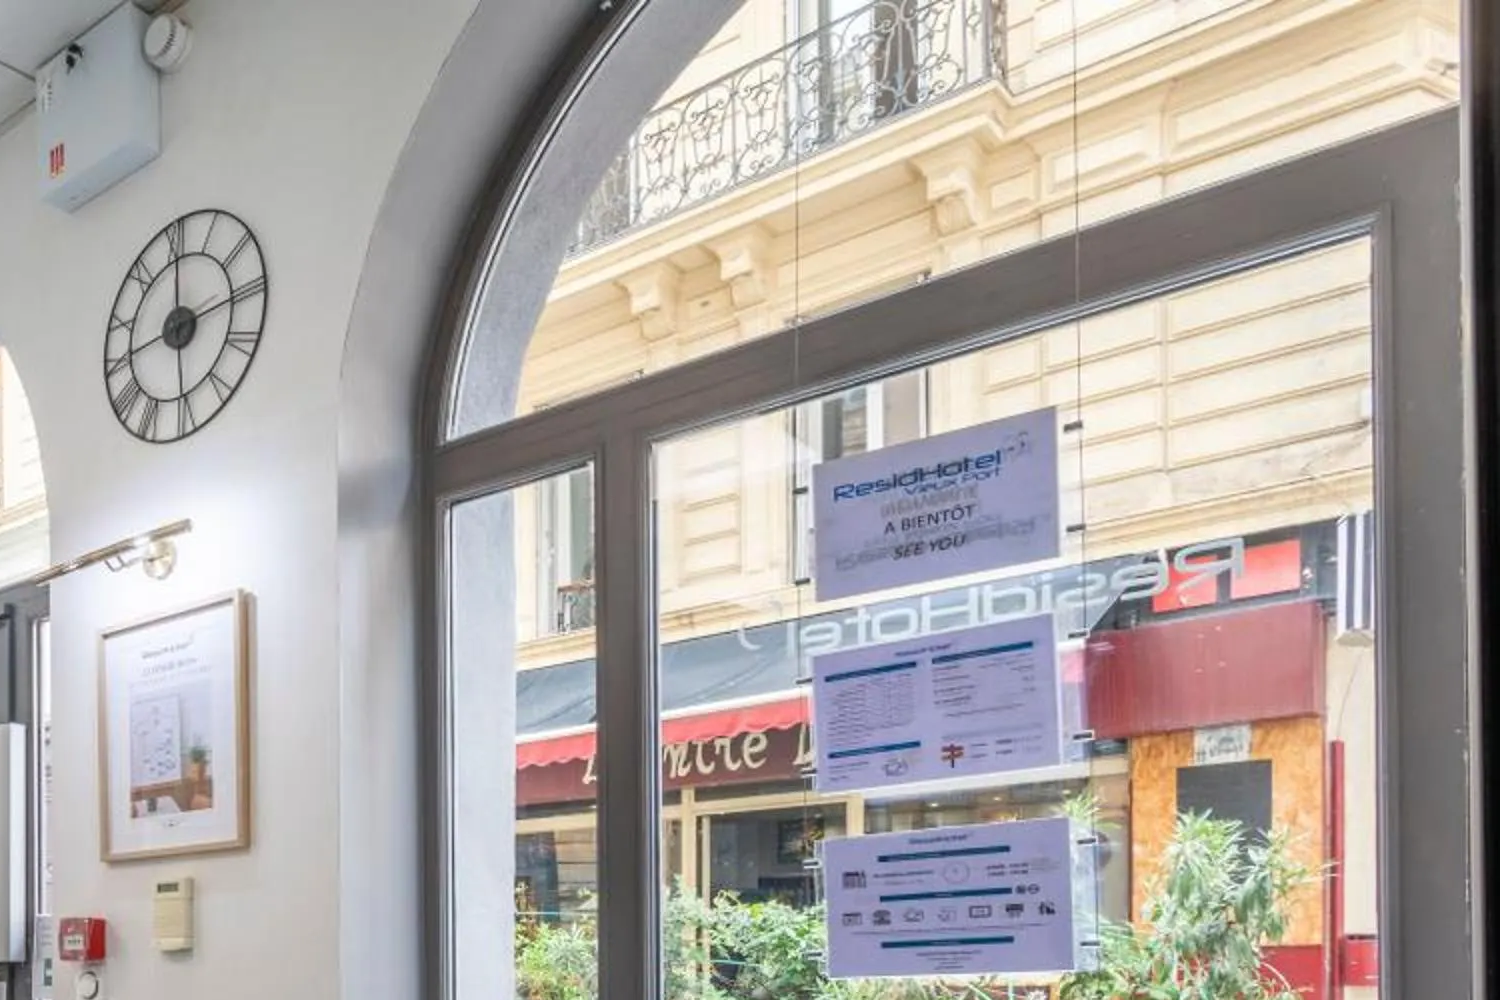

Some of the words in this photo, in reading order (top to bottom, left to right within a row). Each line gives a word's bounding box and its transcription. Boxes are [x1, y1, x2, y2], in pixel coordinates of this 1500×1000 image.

[832, 449, 1002, 502] ResidHotel
[961, 465, 1002, 486] Port
[901, 503, 977, 532] BIENTÔT
[893, 540, 926, 561] SEE
[929, 533, 967, 552] YOU
